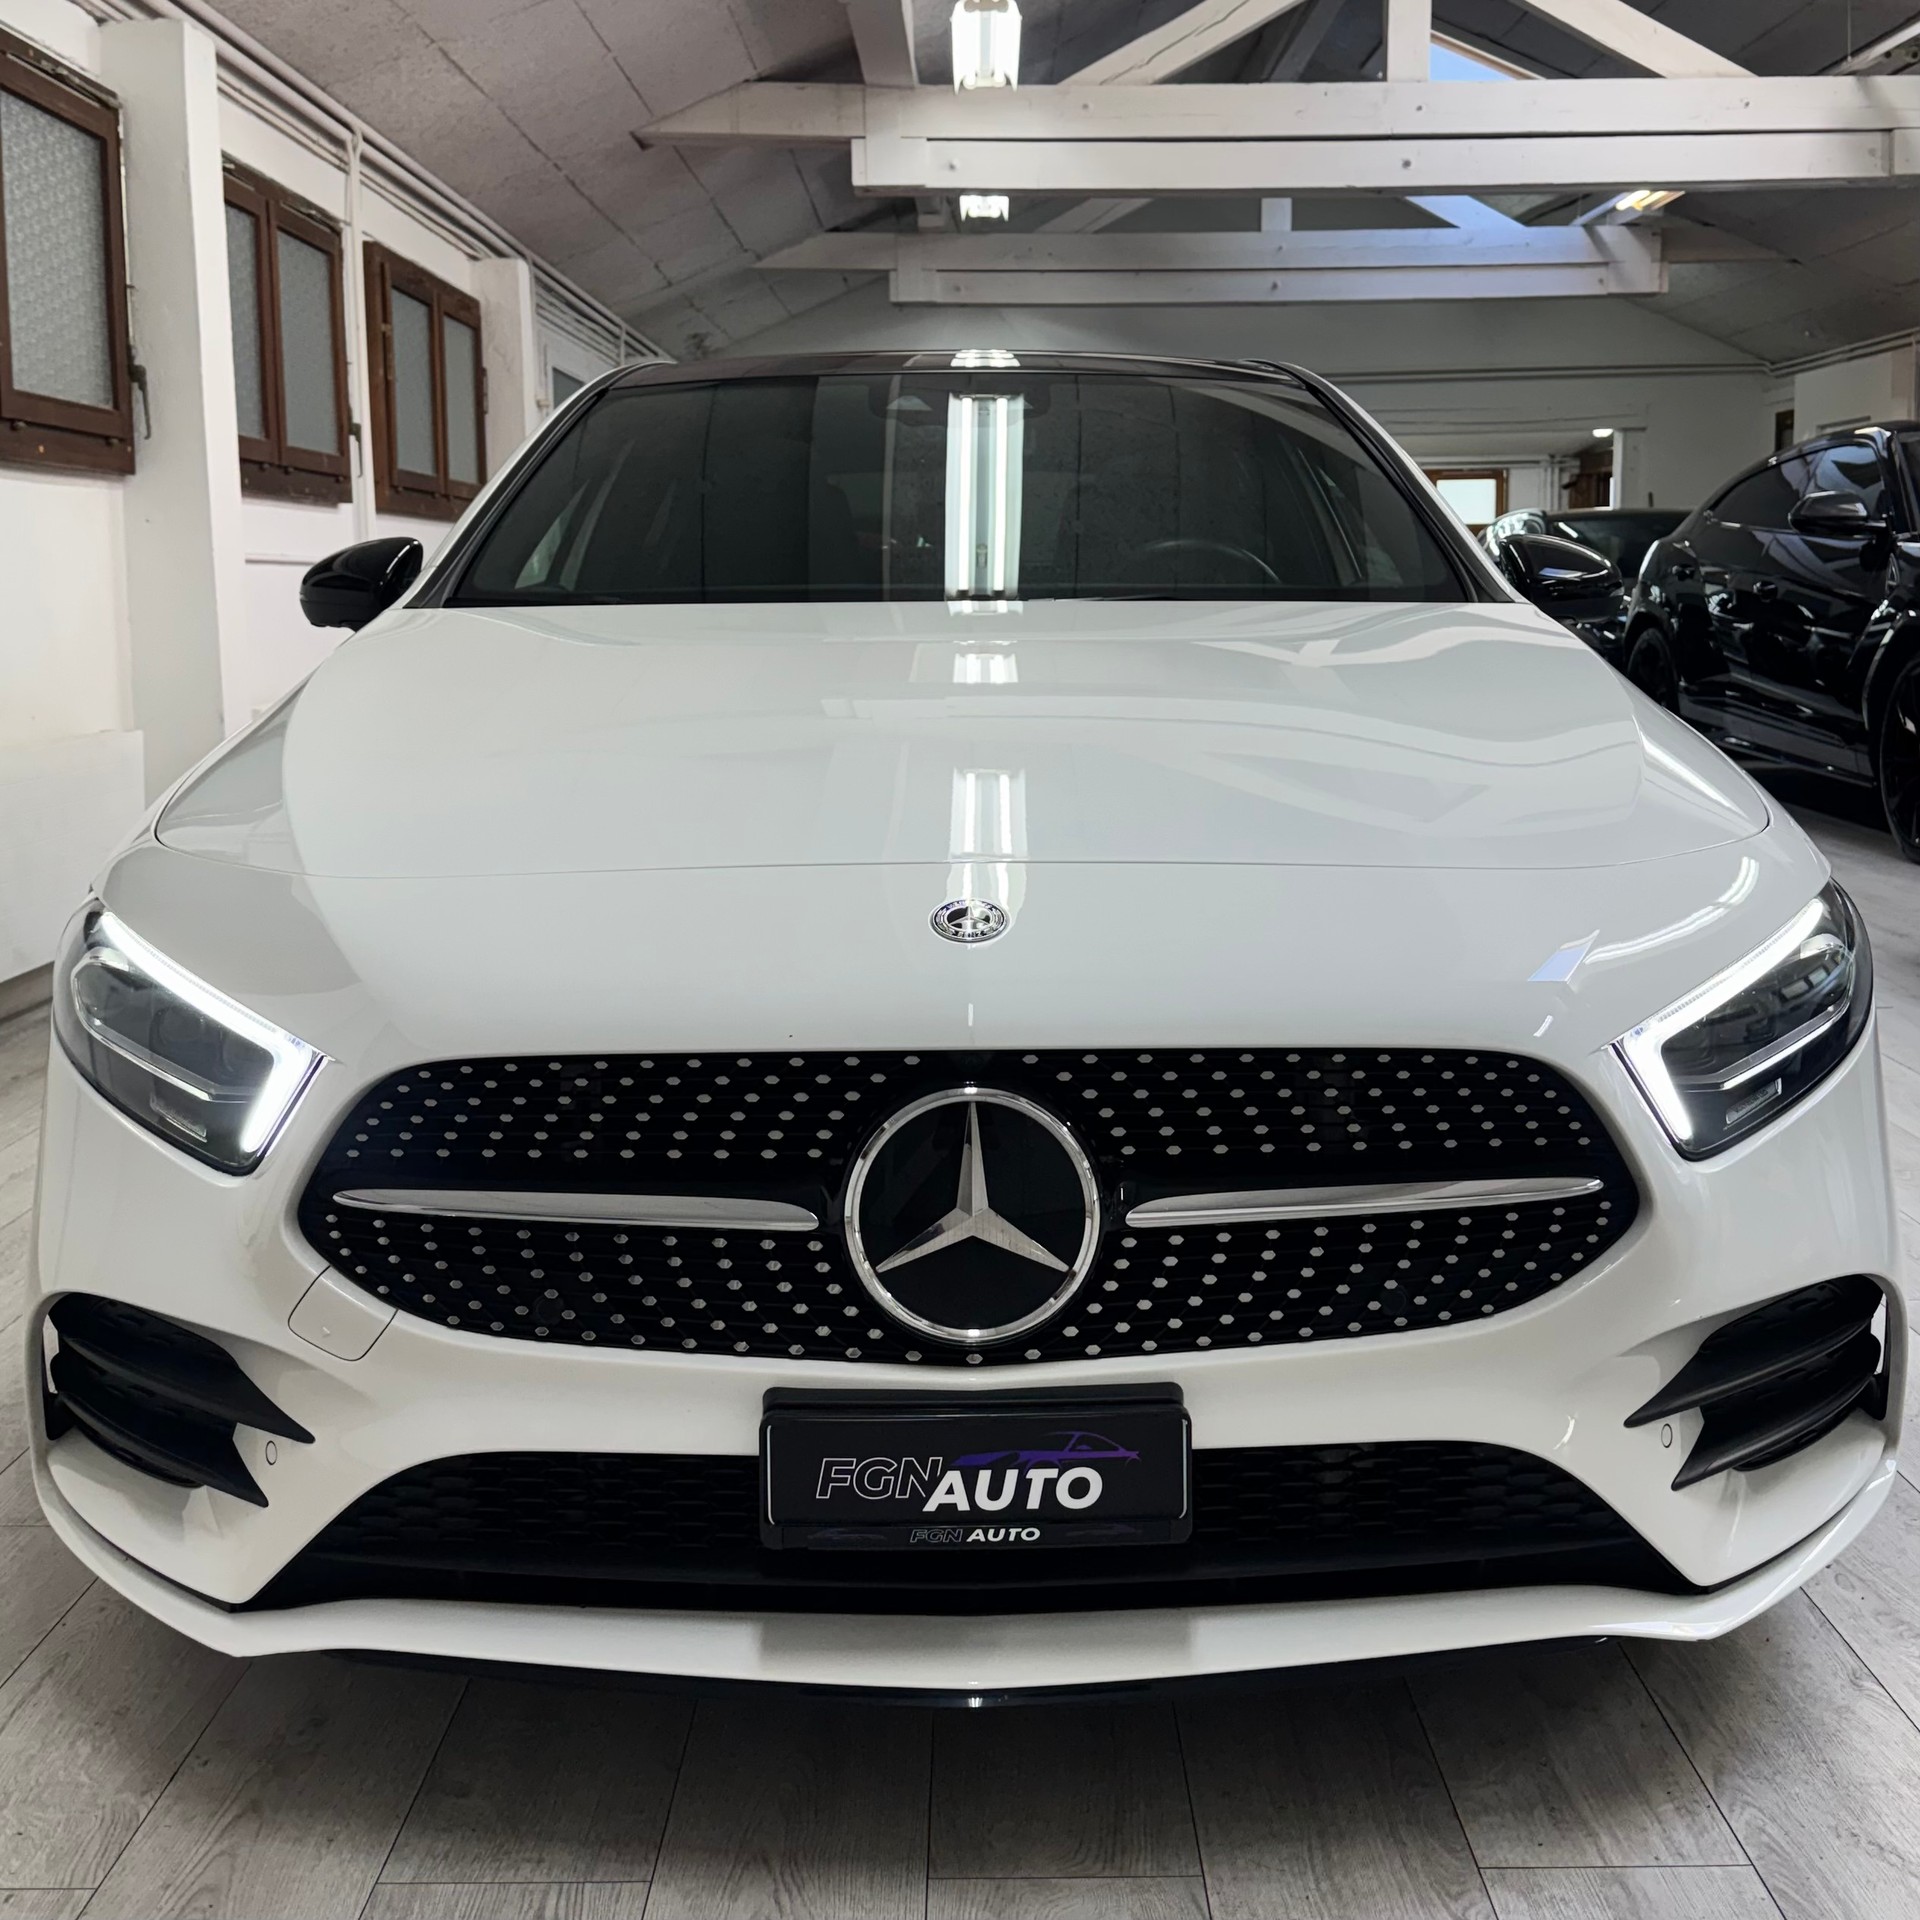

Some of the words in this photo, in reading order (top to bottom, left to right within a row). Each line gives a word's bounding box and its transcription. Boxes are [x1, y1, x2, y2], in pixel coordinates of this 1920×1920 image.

[816, 1457, 943, 1499] FGN
[922, 1466, 1103, 1512] AUTO
[910, 1528, 963, 1543] FGN
[966, 1527, 1041, 1543] AUTO
